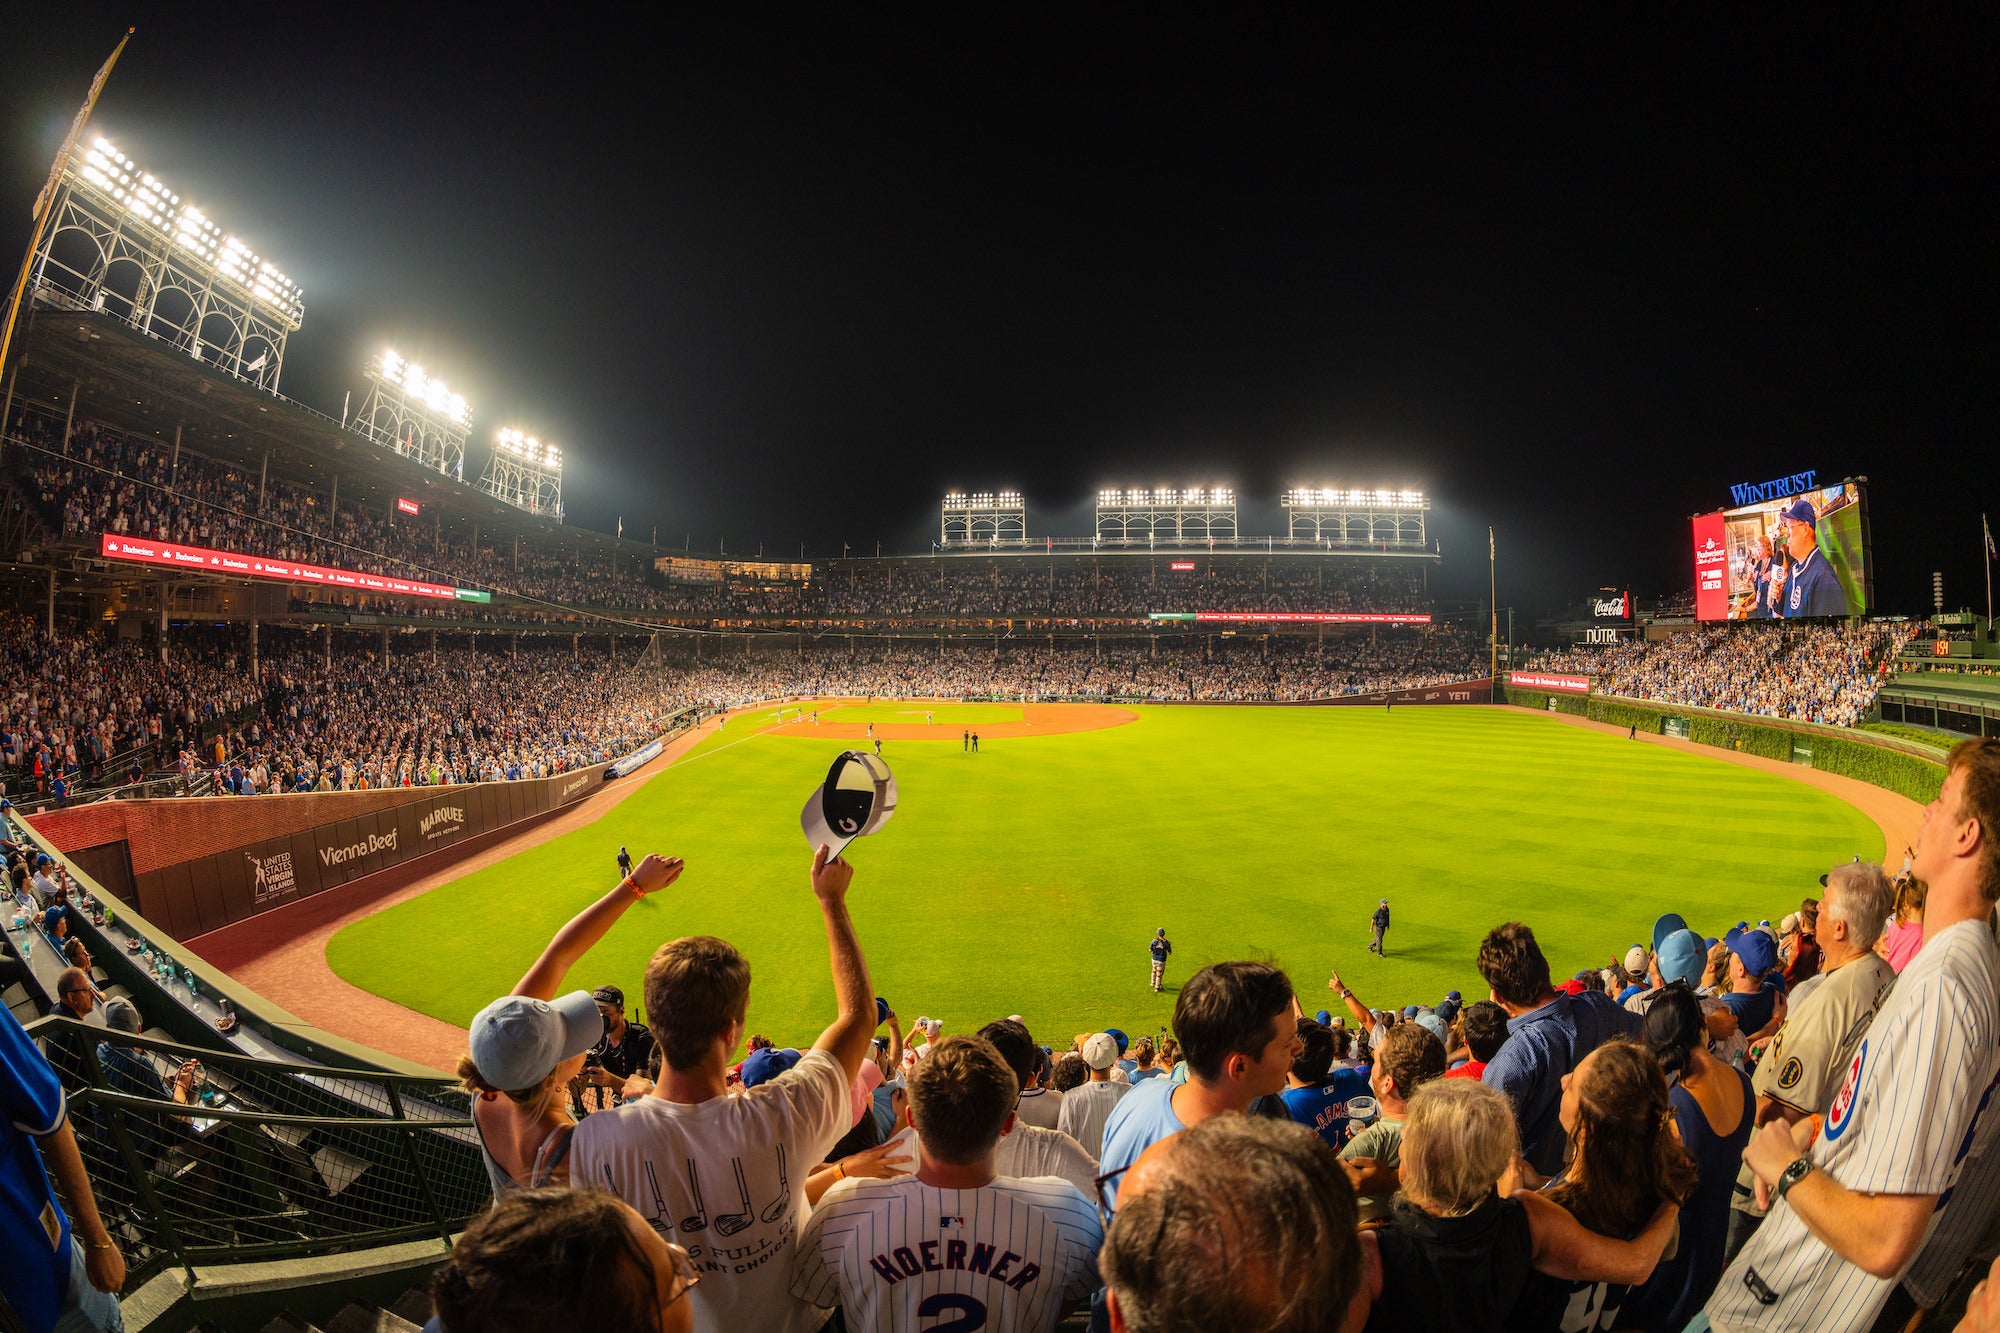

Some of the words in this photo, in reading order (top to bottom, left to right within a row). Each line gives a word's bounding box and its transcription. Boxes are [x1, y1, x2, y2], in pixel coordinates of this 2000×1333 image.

[1730, 470, 1816, 506] WINTRUST
[122, 544, 154, 557] Budweiser
[1448, 691, 1470, 701] YETI
[420, 806, 464, 835] MARQUEE
[319, 839, 368, 867] Vienna
[368, 827, 398, 853] Beef
[263, 852, 291, 867] UNITED
[265, 860, 293, 877] STATES
[266, 869, 294, 885] VIRGIN
[268, 878, 295, 892] ISLANDS
[710, 1238, 772, 1260] FULL
[869, 1239, 1041, 1292] HOERNER
